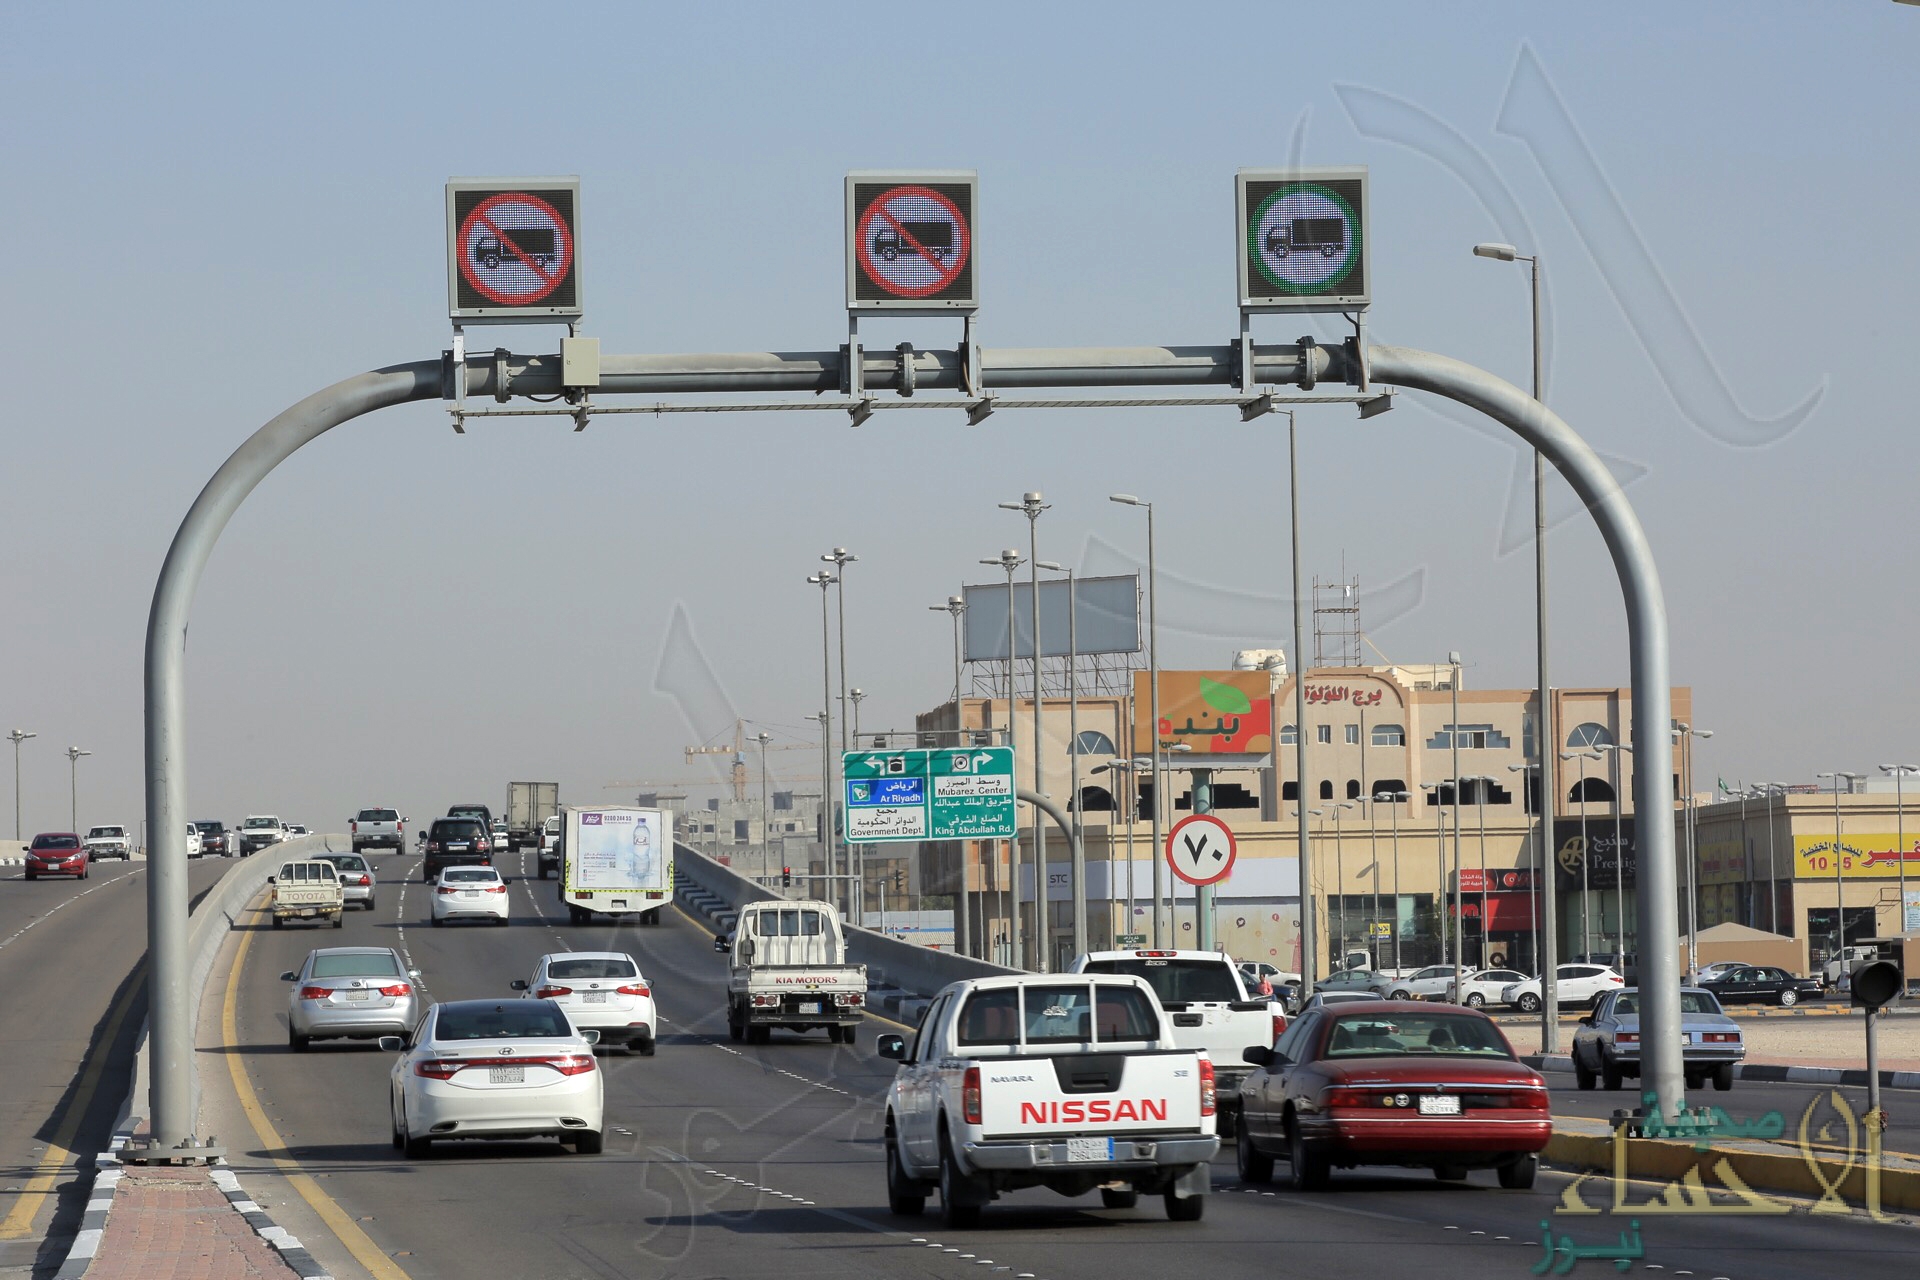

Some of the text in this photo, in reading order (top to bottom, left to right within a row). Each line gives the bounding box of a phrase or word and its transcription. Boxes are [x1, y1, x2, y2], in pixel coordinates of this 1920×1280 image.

[1352, 688, 1383, 706] برج
[886, 780, 918, 792] الرياض
[945, 777, 1001, 788] وسط المبرز
[938, 786, 1008, 796] Mubarez Center
[880, 793, 921, 804] Ar Riyadh
[934, 796, 1013, 808] طريق الملك عبدالله
[876, 808, 898, 816] مجمع
[857, 816, 917, 828] الدوائر الحكومية
[850, 826, 924, 836] Government Dept.
[935, 825, 1013, 836] King Abdullah Rd.
[1183, 833, 1223, 866] ٧٠
[1832, 843, 1863, 857] للبضاع
[1593, 855, 1636, 873] Presig
[1809, 857, 1829, 871] 10
[1843, 857, 1853, 870] 5
[1050, 874, 1068, 883] STC
[287, 892, 326, 901] TOYOTA
[795, 976, 838, 984] MOTORS
[990, 1070, 1189, 1083] NAVARA SE
[1021, 1099, 1168, 1124] NISSAN
